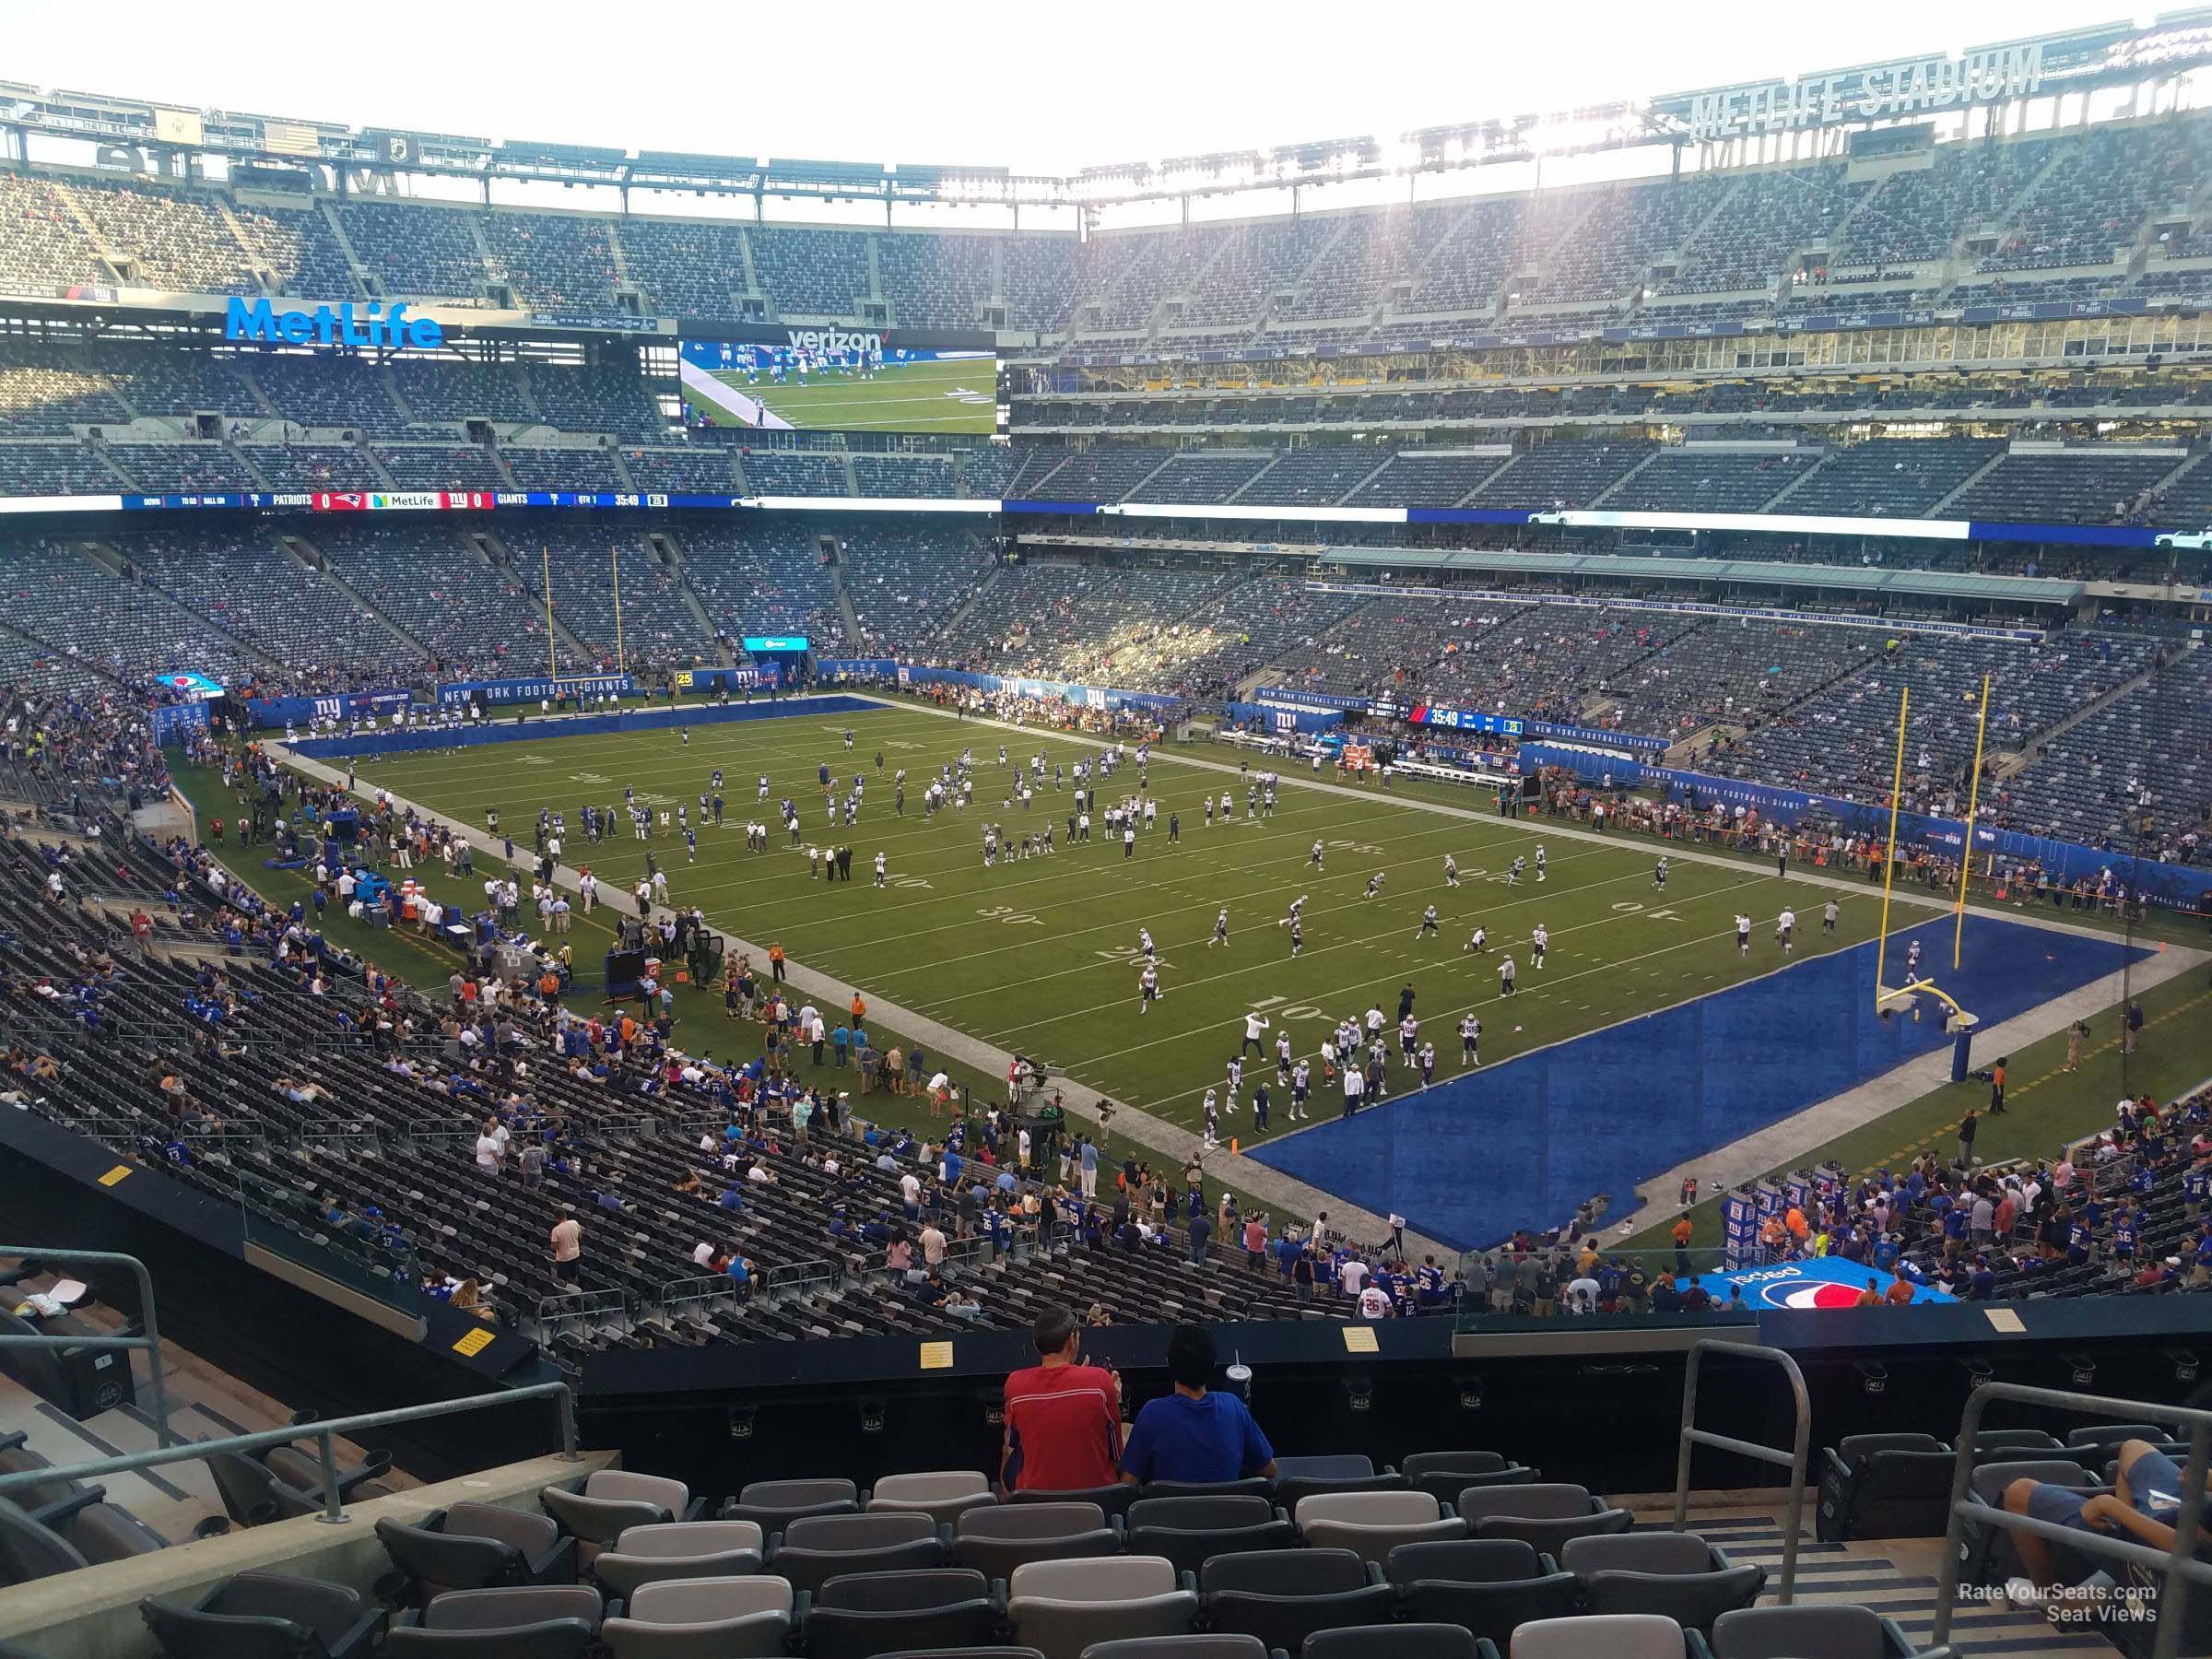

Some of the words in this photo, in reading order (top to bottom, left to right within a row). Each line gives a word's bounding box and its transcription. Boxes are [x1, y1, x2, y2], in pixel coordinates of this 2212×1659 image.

[1690, 73, 1845, 139] METLIFE
[1859, 43, 2044, 117] STADIUM
[227, 296, 443, 348] MetLife
[788, 326, 881, 351] verizon
[273, 494, 312, 506] PATRIOTS
[322, 493, 331, 508] 0
[392, 496, 434, 506] MetLife
[473, 493, 482, 507] 0
[497, 494, 528, 504] GIANTS
[615, 494, 639, 506] 35:49
[677, 673, 691, 684] 25
[444, 690, 472, 703] NEW
[478, 688, 511, 699] ORK
[517, 682, 576, 697] FOOTBALL
[584, 679, 629, 692] GIANTS
[1279, 692, 1295, 700] YORK
[1298, 695, 1330, 704] FOOTBALL
[1334, 699, 1359, 708] GIANTS
[1431, 710, 1458, 726] 35:49
[1535, 725, 1551, 734] NEW
[1557, 728, 1577, 737] YORK
[1582, 732, 1623, 745] FOOTBALL
[1628, 737, 1660, 749] GIANTS
[1640, 769, 1672, 780] GIANTS
[1698, 785, 1718, 795] YORK
[1724, 790, 1767, 805] FOOTBALL
[1772, 798, 1804, 810] GIANT
[976, 905, 1038, 924] 30
[1094, 946, 1167, 968] 20
[1245, 994, 1323, 1020] 10
[1418, 1275, 1431, 1290] 26
[1725, 1266, 1803, 1287] pepsi
[1366, 1299, 1380, 1312] 26
[1406, 1305, 1416, 1316] 12
